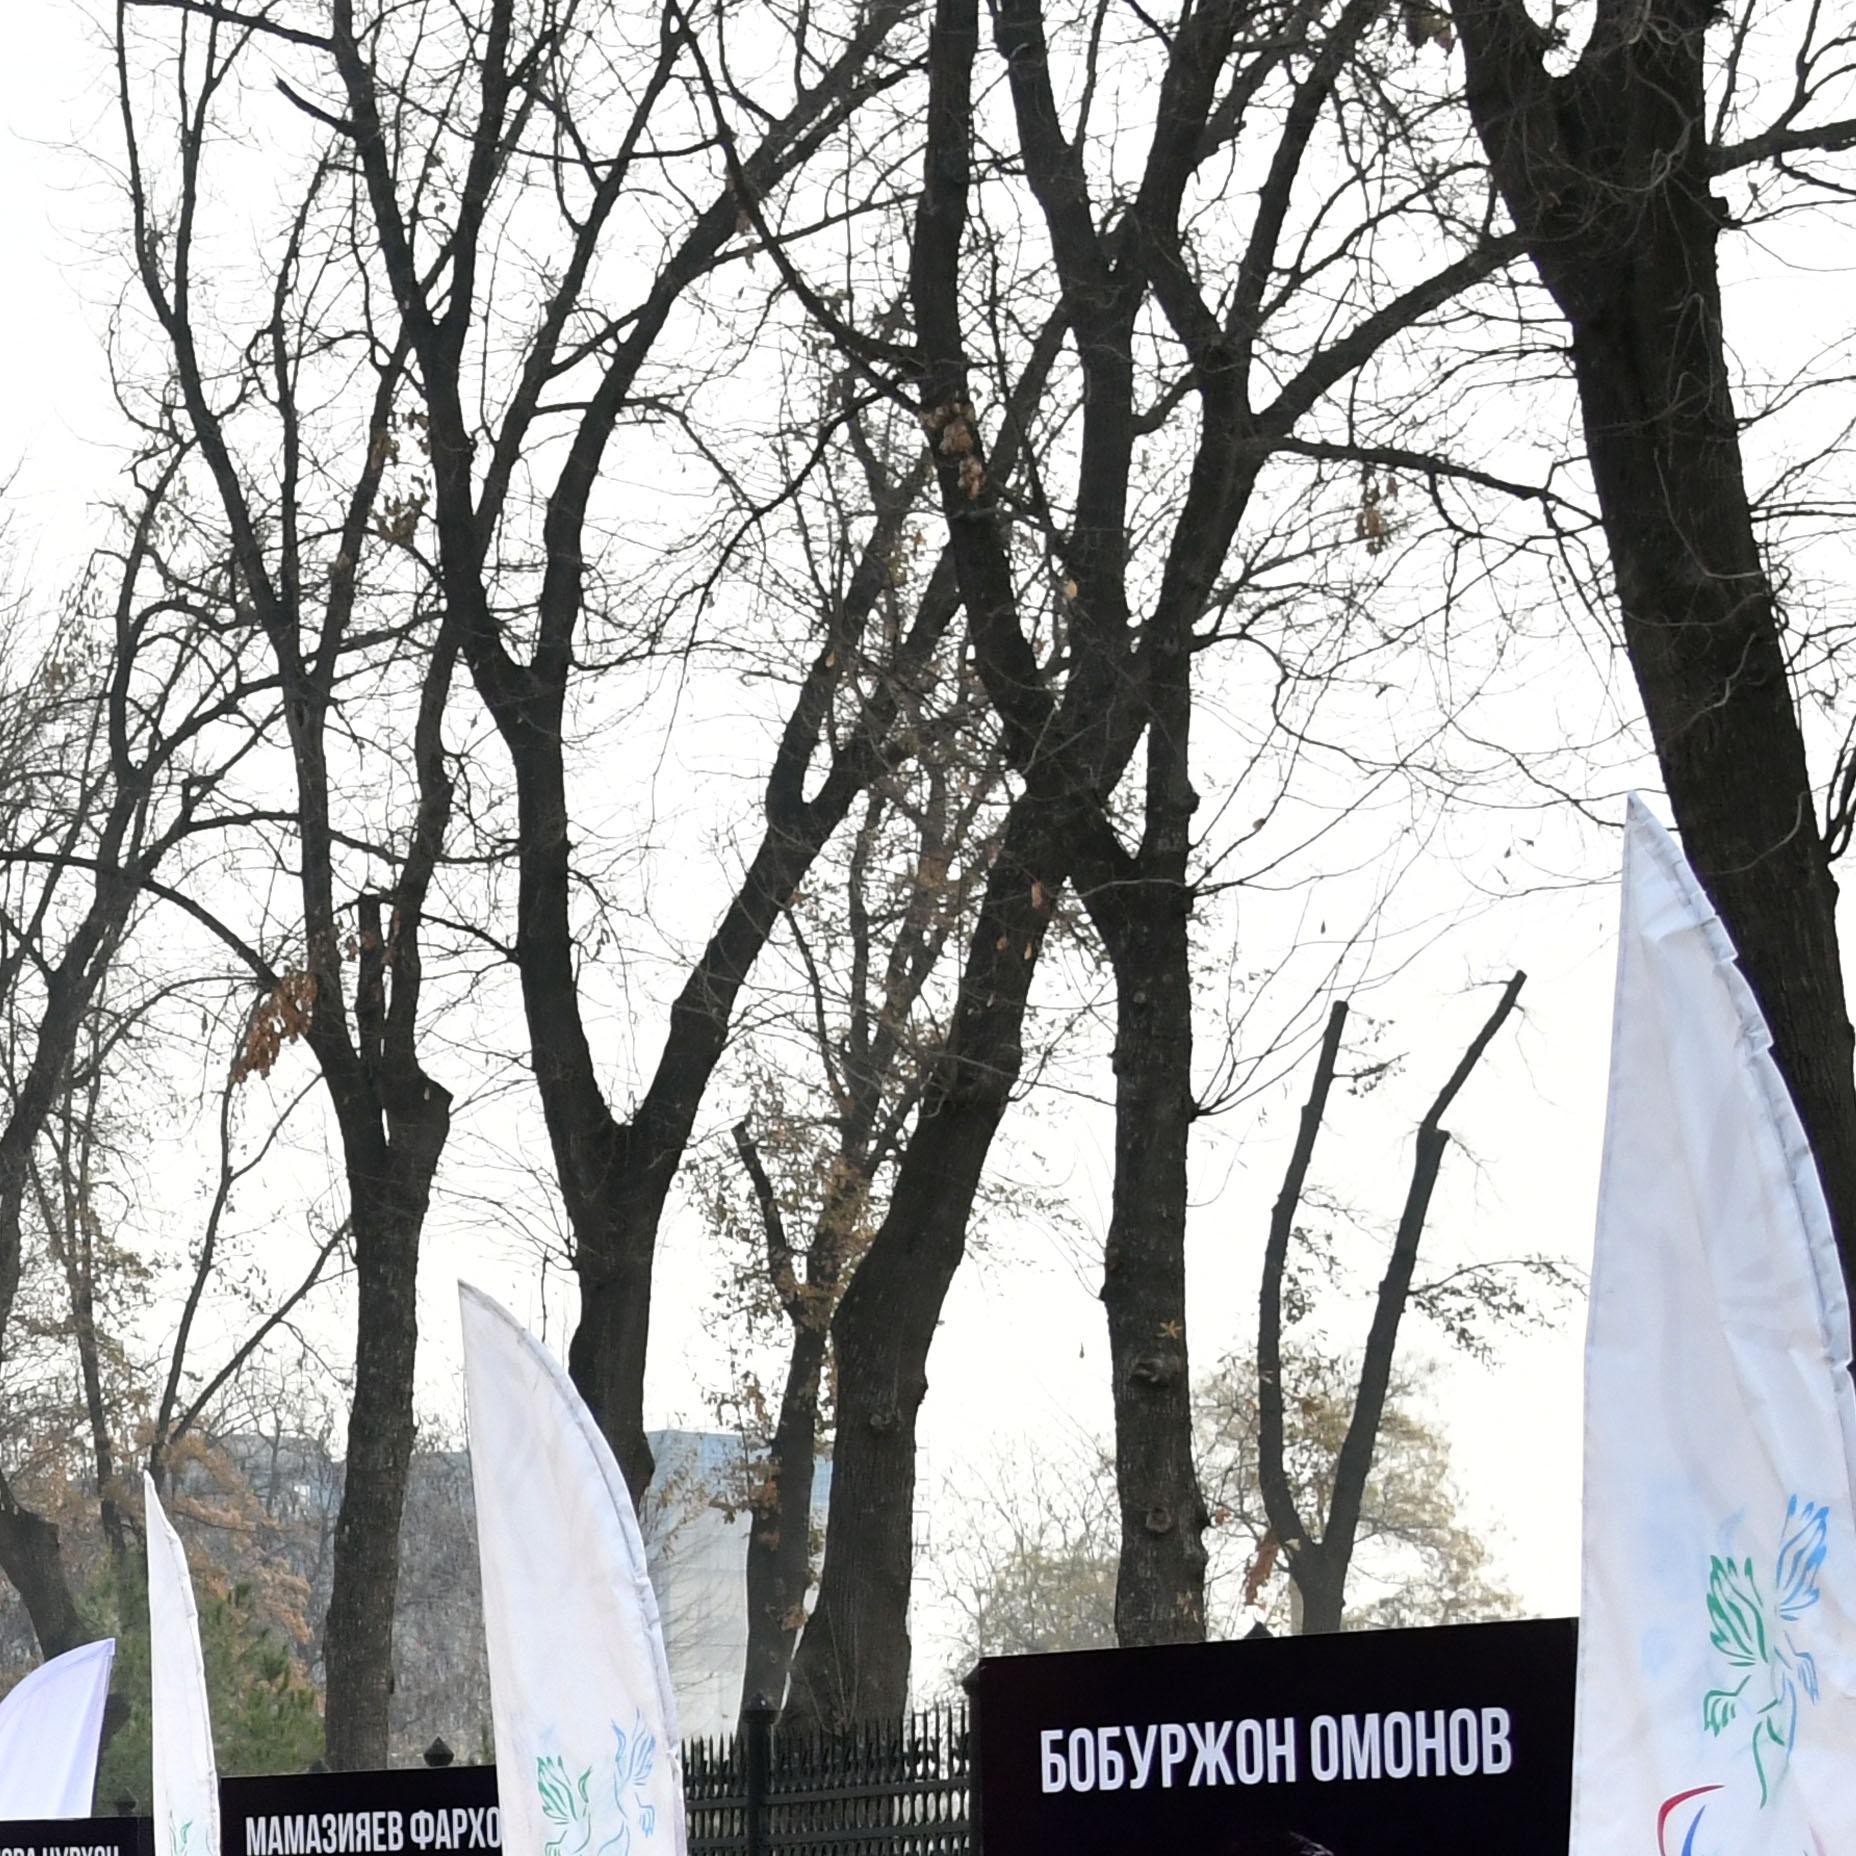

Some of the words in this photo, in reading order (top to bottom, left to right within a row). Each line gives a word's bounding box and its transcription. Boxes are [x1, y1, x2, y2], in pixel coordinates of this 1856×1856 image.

[1040, 1716, 1297, 1793] БОБУРЖОН
[1309, 1706, 1513, 1781] ОМОНОВ
[245, 1810, 404, 1856] МАМАЗИЯЕВ
